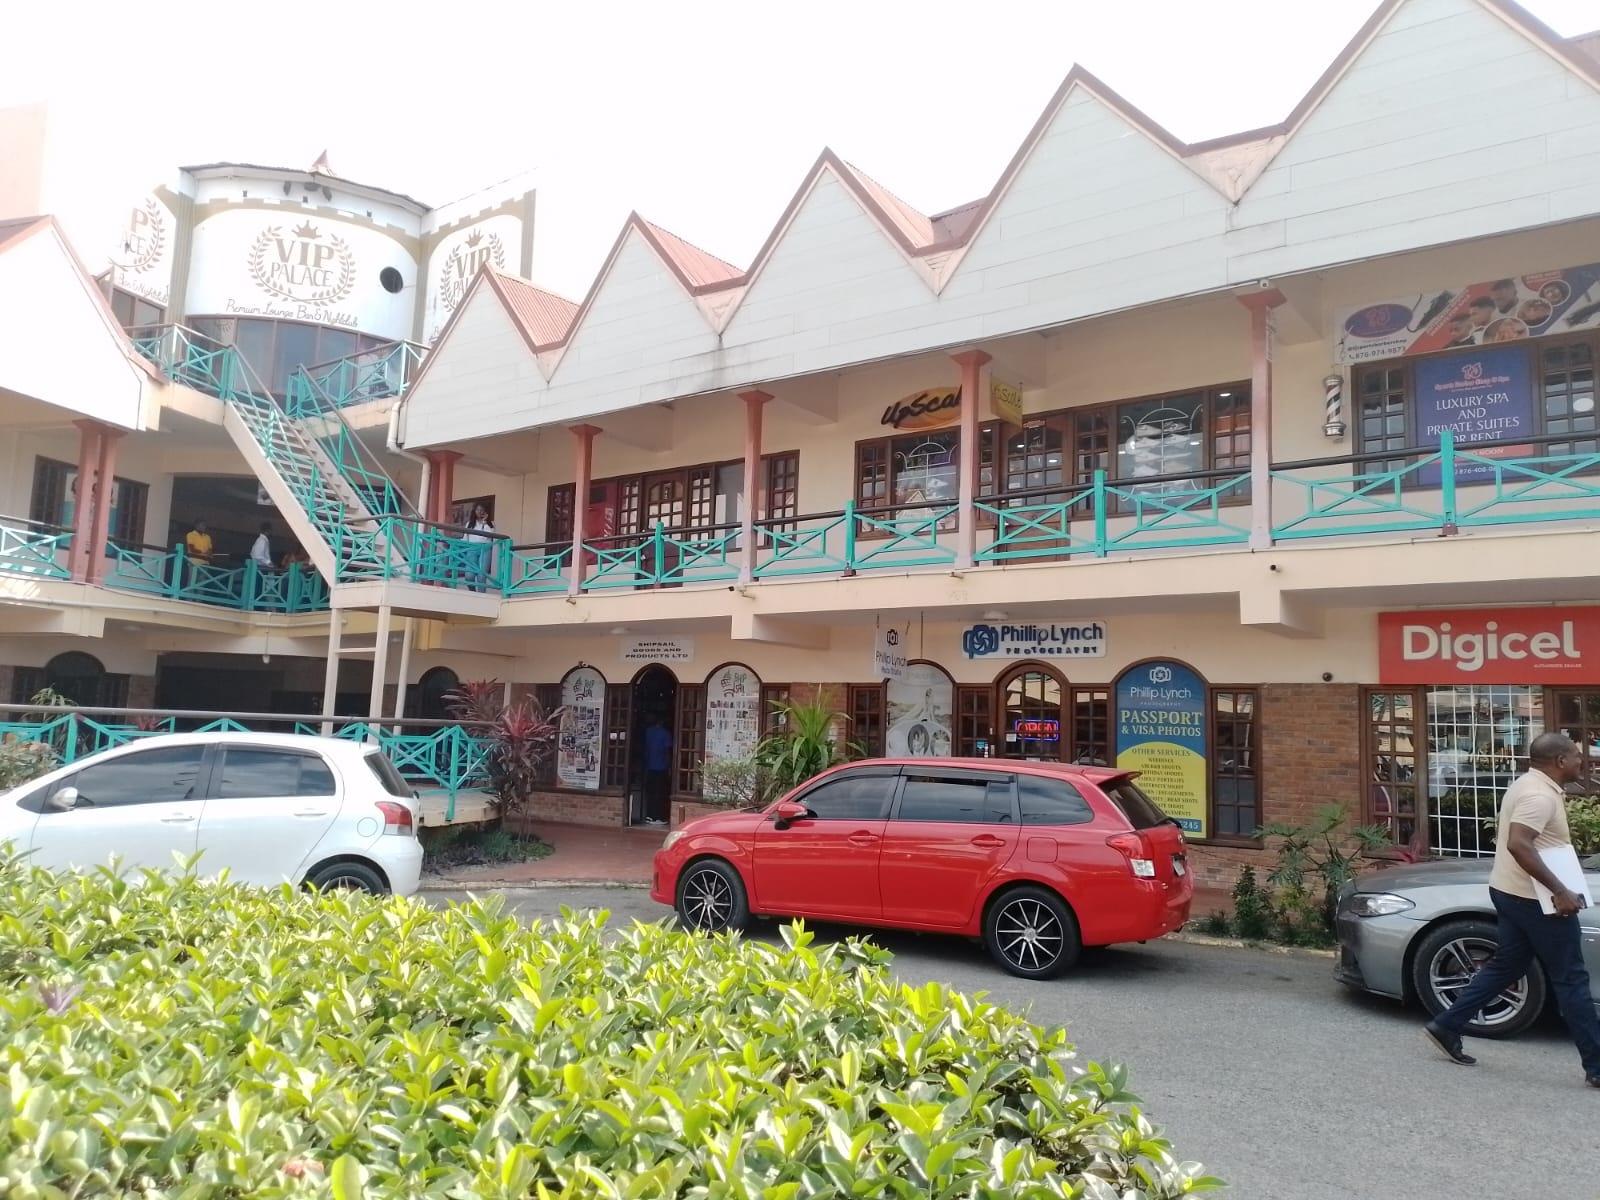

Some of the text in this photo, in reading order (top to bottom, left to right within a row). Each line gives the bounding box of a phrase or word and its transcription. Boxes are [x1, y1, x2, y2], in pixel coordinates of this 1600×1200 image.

[275, 238, 335, 268] VIP
[456, 246, 491, 279] VIP
[270, 262, 334, 287] PALACE
[225, 299, 261, 314] Premium
[262, 301, 294, 318] Lounge
[880, 384, 962, 429] UpScal
[1436, 392, 1510, 411] LUXURY SPA
[1457, 407, 1486, 420] AND
[1427, 416, 1520, 436] PRIVATE SUITES
[1470, 431, 1504, 442] RENT
[1001, 623, 1103, 646] Phillip Lynch
[1006, 646, 1097, 655] PHOTOGRAPHY
[1402, 620, 1581, 672] Digicel
[1130, 686, 1192, 700] Phillip Lynch
[1120, 709, 1203, 726] PASSPORT
[1121, 725, 1201, 737] & VISA PHOTOS
[1157, 749, 1191, 757] SERVICES
